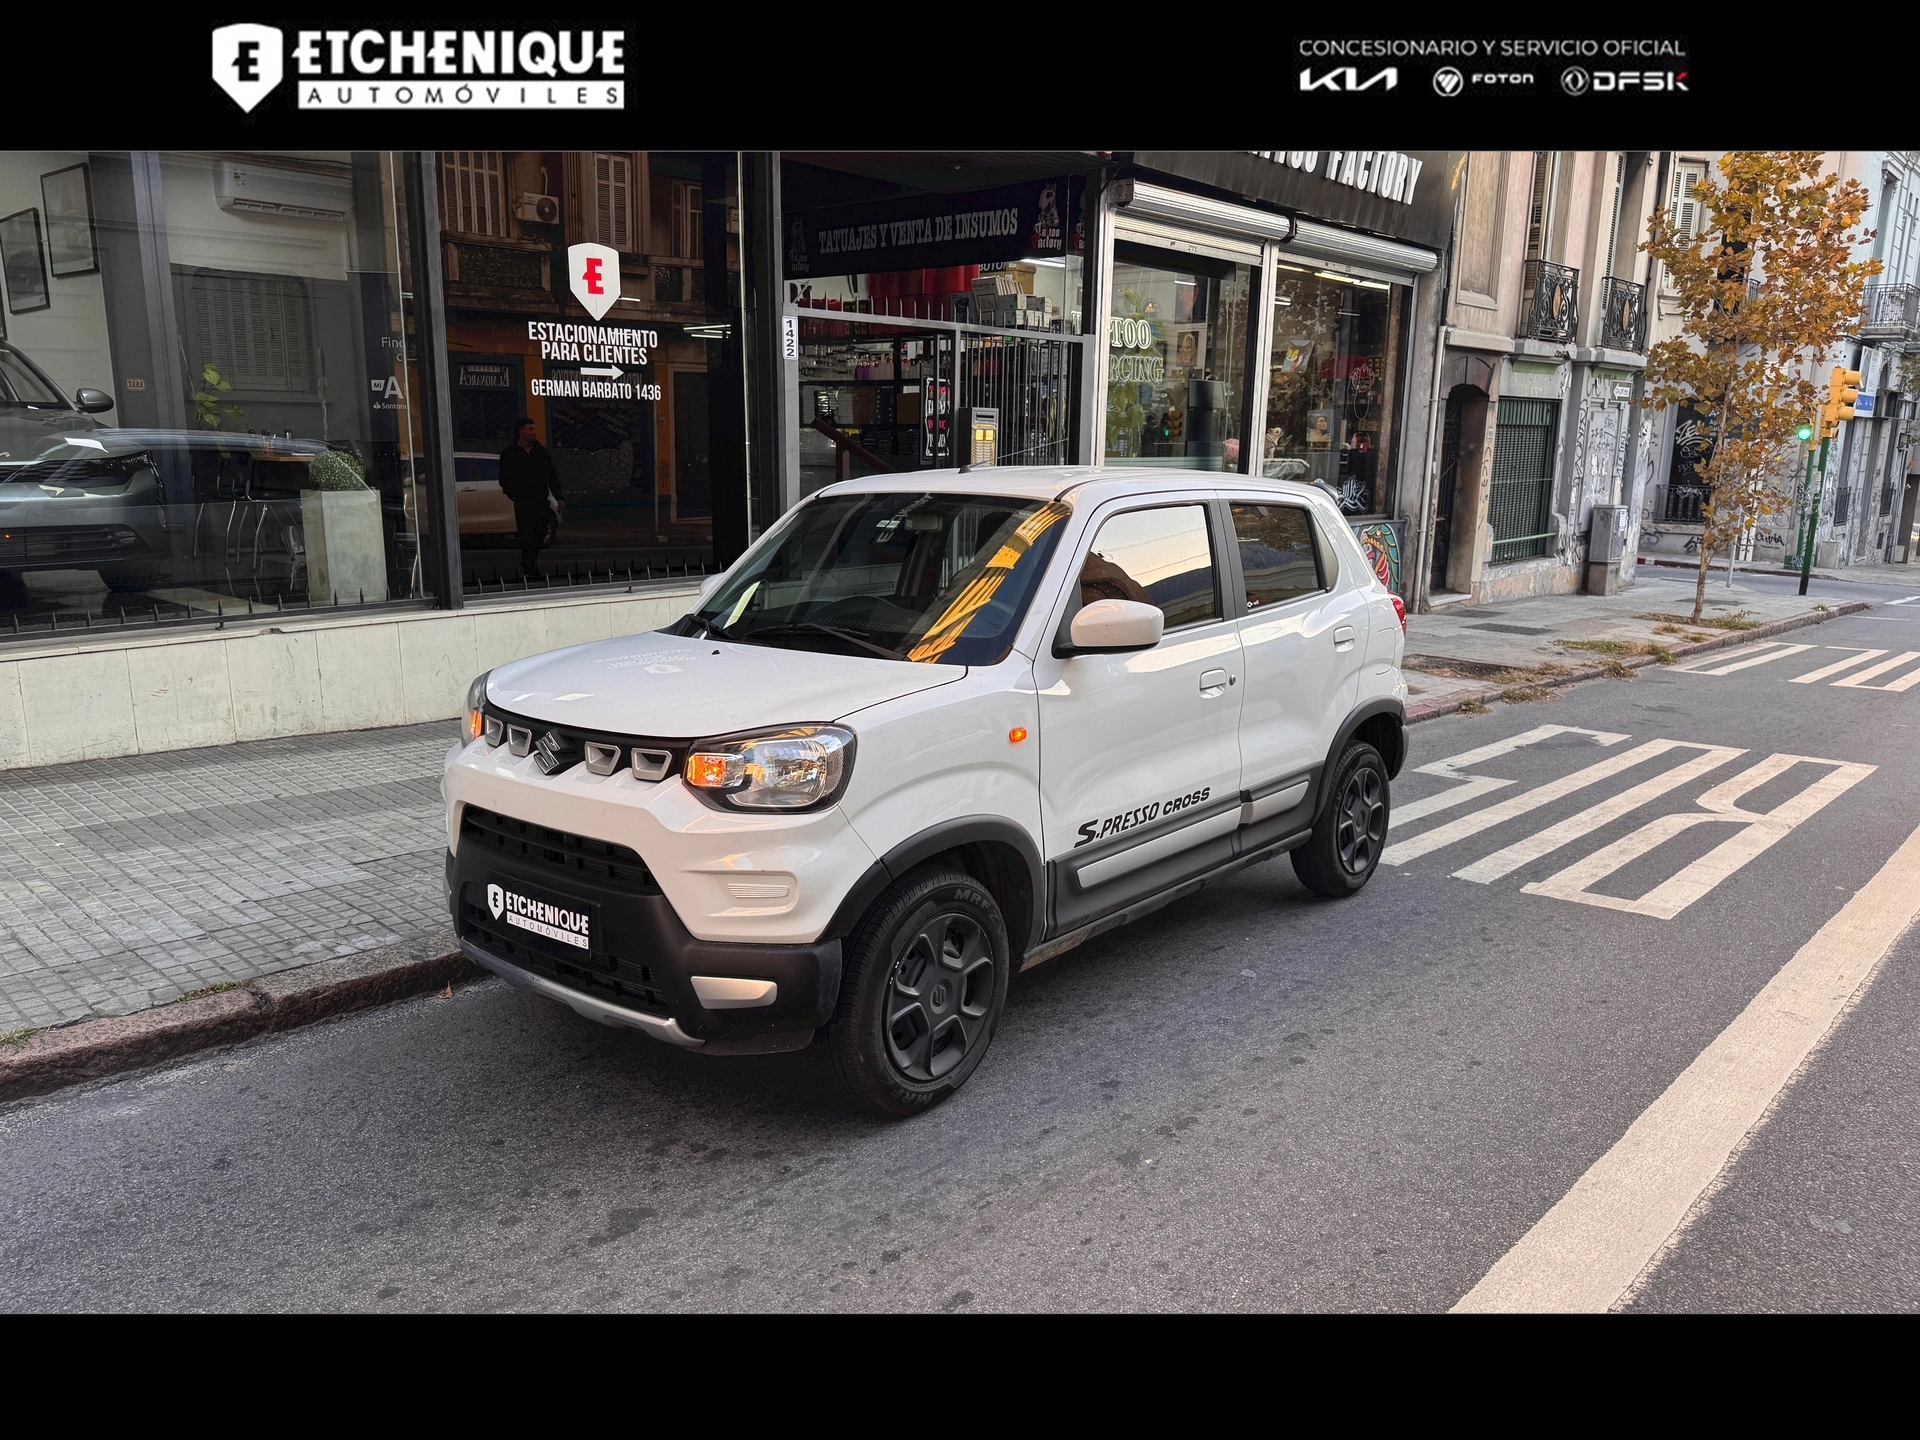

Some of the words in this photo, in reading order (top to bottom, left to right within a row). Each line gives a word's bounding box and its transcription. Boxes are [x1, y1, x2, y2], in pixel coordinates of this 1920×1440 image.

[1325, 151, 1423, 205] FACTORY
[818, 225, 878, 254] TATUAJES
[878, 224, 889, 248] Y
[890, 217, 933, 246] VENTA
[934, 214, 953, 242] DE
[954, 207, 1018, 239] INSUMOS
[527, 321, 658, 348] ESTACIONAMIENTO
[785, 319, 795, 357] 1422
[541, 341, 580, 361] PARA
[583, 345, 648, 365] CLIENTES
[531, 379, 580, 398] GERMAN
[582, 382, 632, 400] BARBATO
[635, 385, 662, 400] 1436
[1162, 787, 1211, 816] CROSS
[506, 891, 589, 936] ETCHENIQUE
[954, 887, 992, 910] MRF
[508, 914, 588, 947] AUTOMÓVILES
